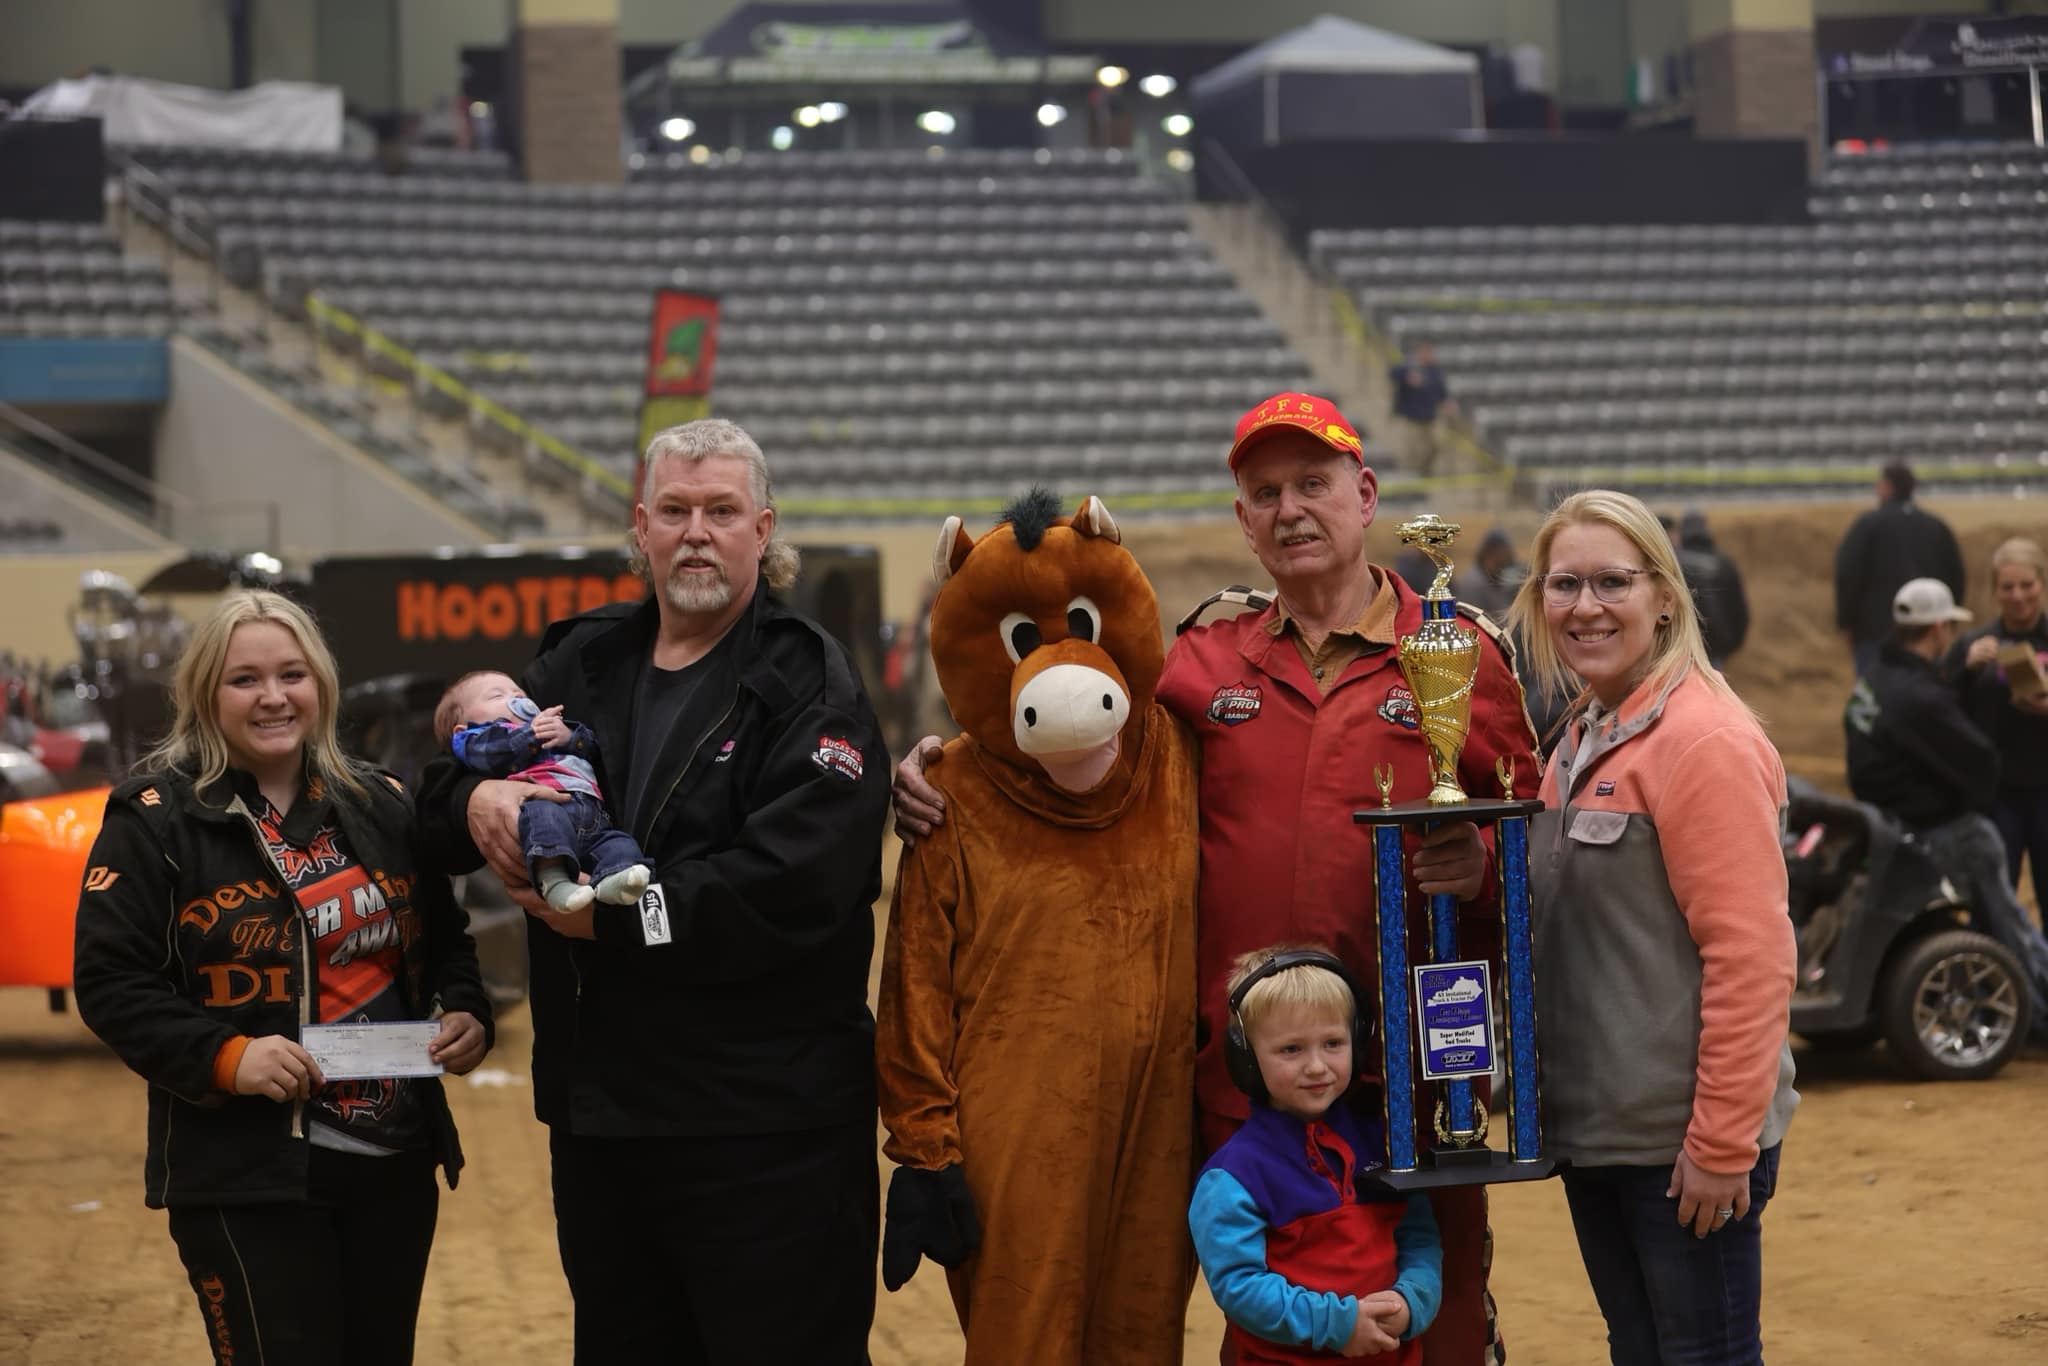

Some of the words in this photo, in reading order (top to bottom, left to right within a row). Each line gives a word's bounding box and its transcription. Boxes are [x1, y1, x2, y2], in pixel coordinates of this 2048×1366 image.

[1217, 689, 1245, 697] LUCAS
[1228, 700, 1255, 709] PRO
[838, 754, 860, 771] PRO
[1454, 1030, 1475, 1038] Modified
